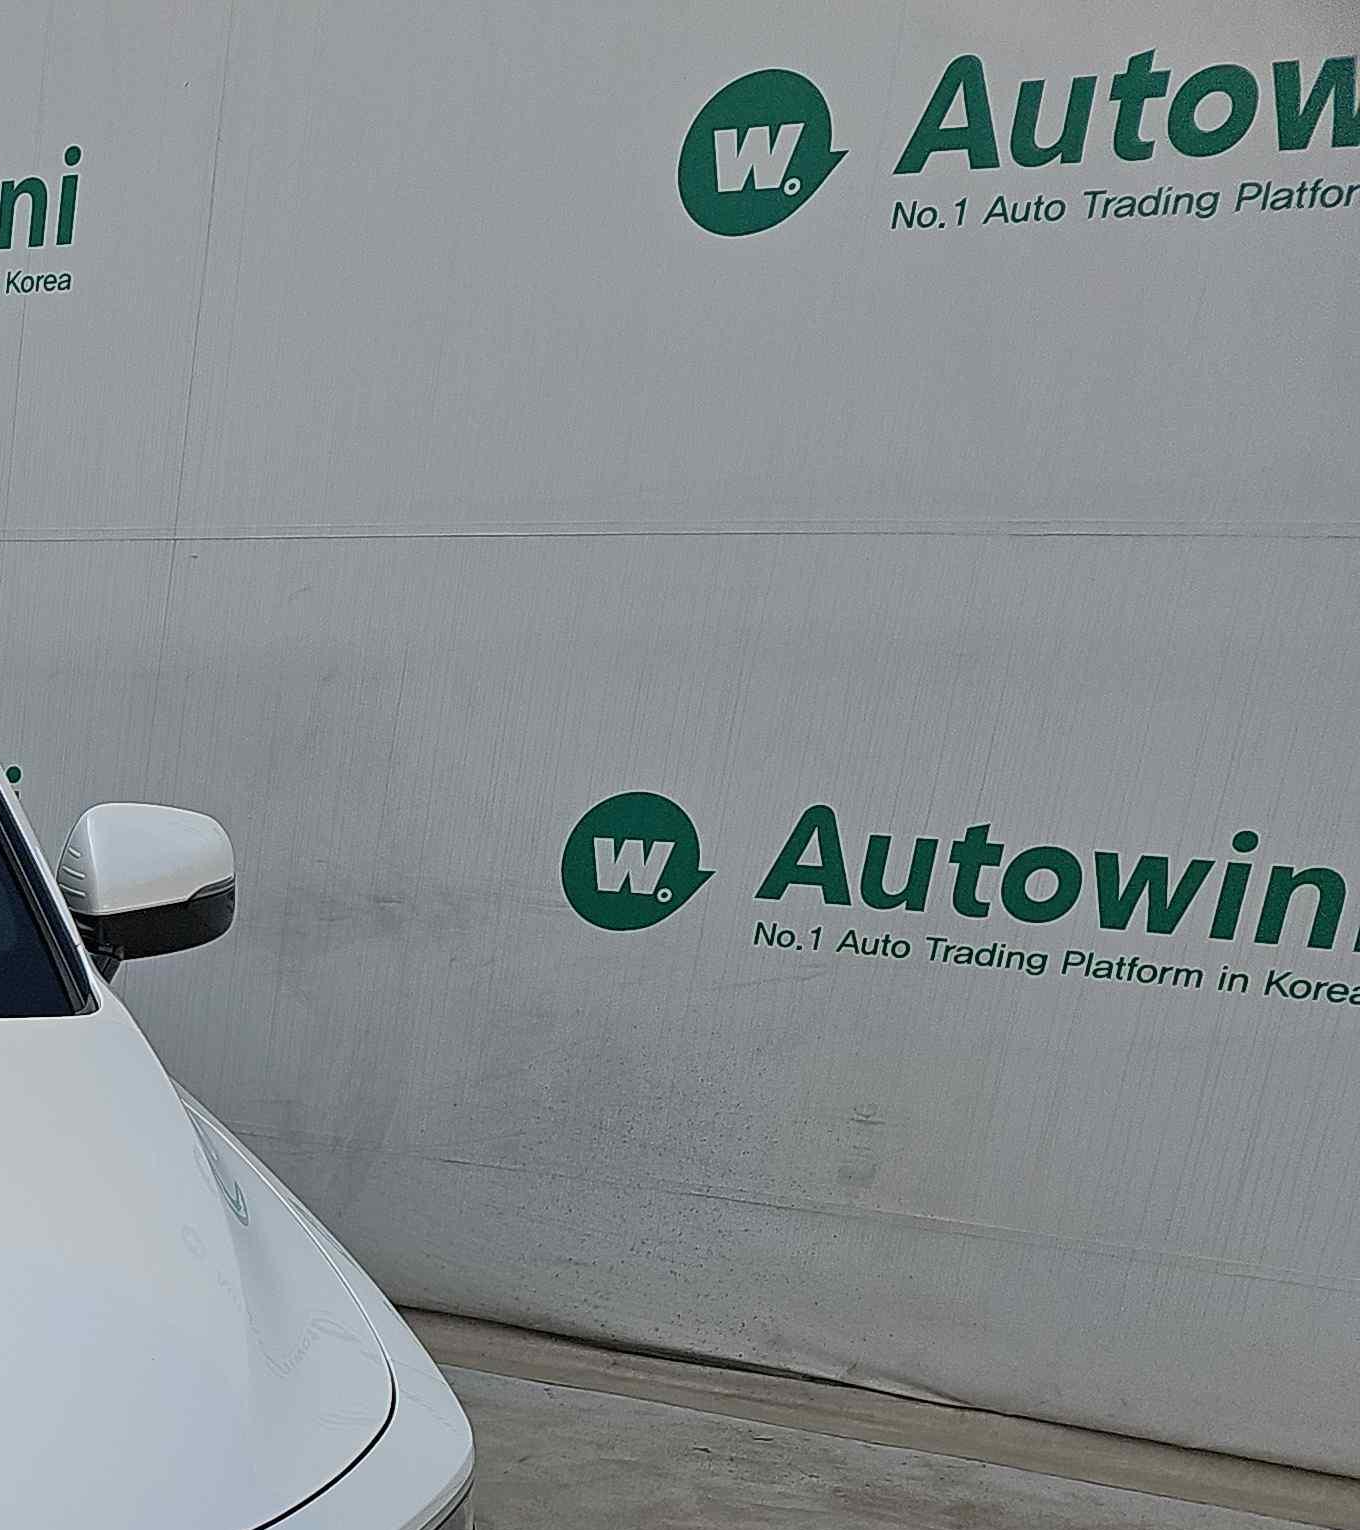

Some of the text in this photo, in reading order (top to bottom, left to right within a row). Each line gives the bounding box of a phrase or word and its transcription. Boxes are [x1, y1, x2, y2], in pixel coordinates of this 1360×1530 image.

[891, 198, 967, 230] No.1
[982, 193, 1066, 226] Auto
[1083, 184, 1219, 221] Trading
[6, 270, 72, 294] Korea
[754, 803, 1360, 955] Autowin
[753, 920, 823, 953] No.1
[836, 927, 913, 961] Auto
[924, 934, 1049, 977] Trading
[1062, 948, 1204, 990] Platform
[1217, 962, 1250, 995] in
